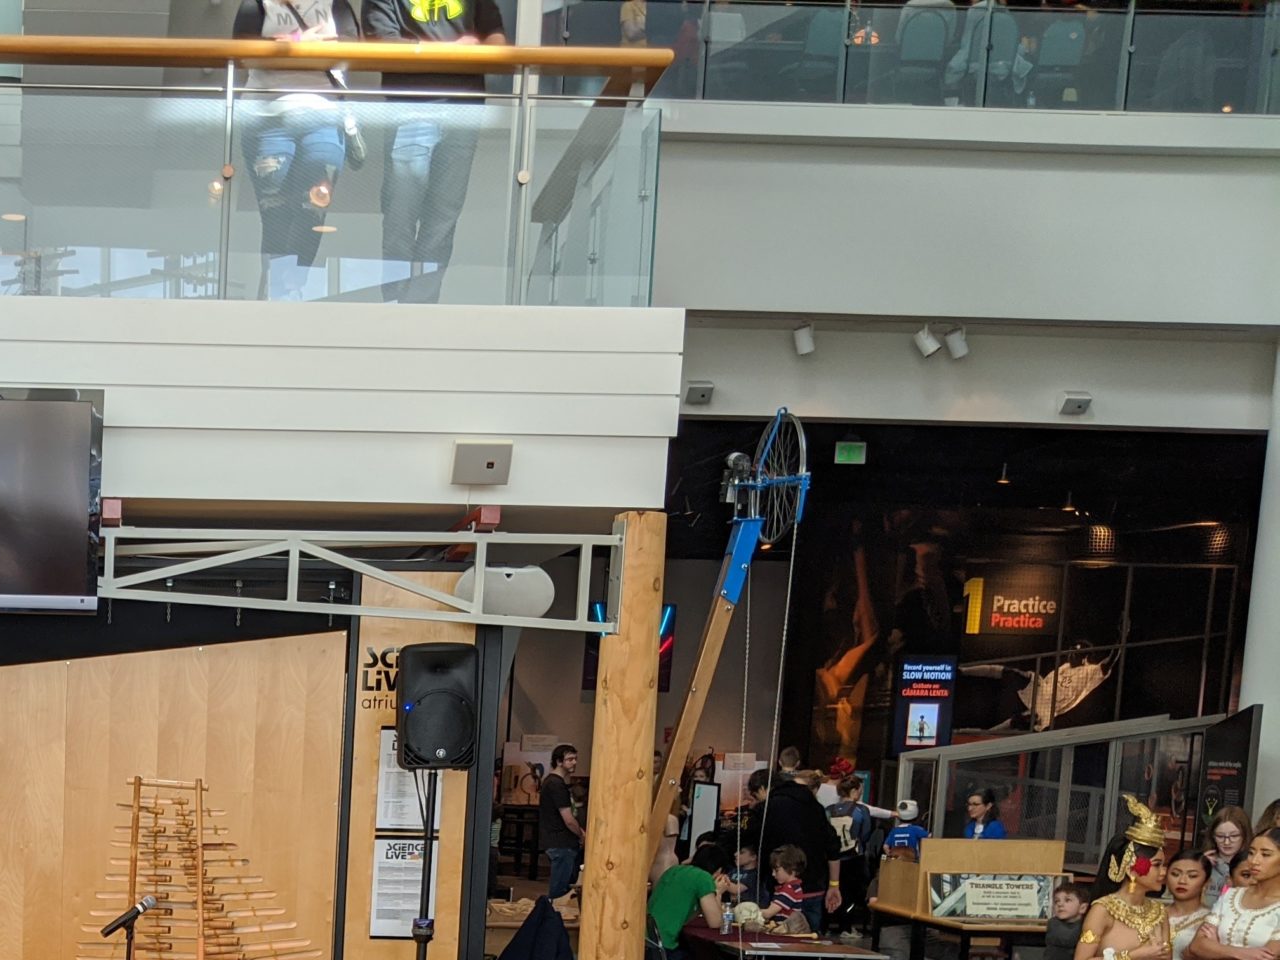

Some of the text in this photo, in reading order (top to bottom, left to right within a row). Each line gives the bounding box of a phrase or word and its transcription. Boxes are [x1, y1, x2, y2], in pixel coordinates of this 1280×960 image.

[963, 577, 984, 634] 1
[992, 595, 1056, 614] Practice
[991, 613, 1044, 628] Practica
[904, 663, 921, 671] Record
[922, 664, 945, 672] yourself
[902, 671, 952, 680] SLOW MOTION
[929, 689, 948, 697] LENTA
